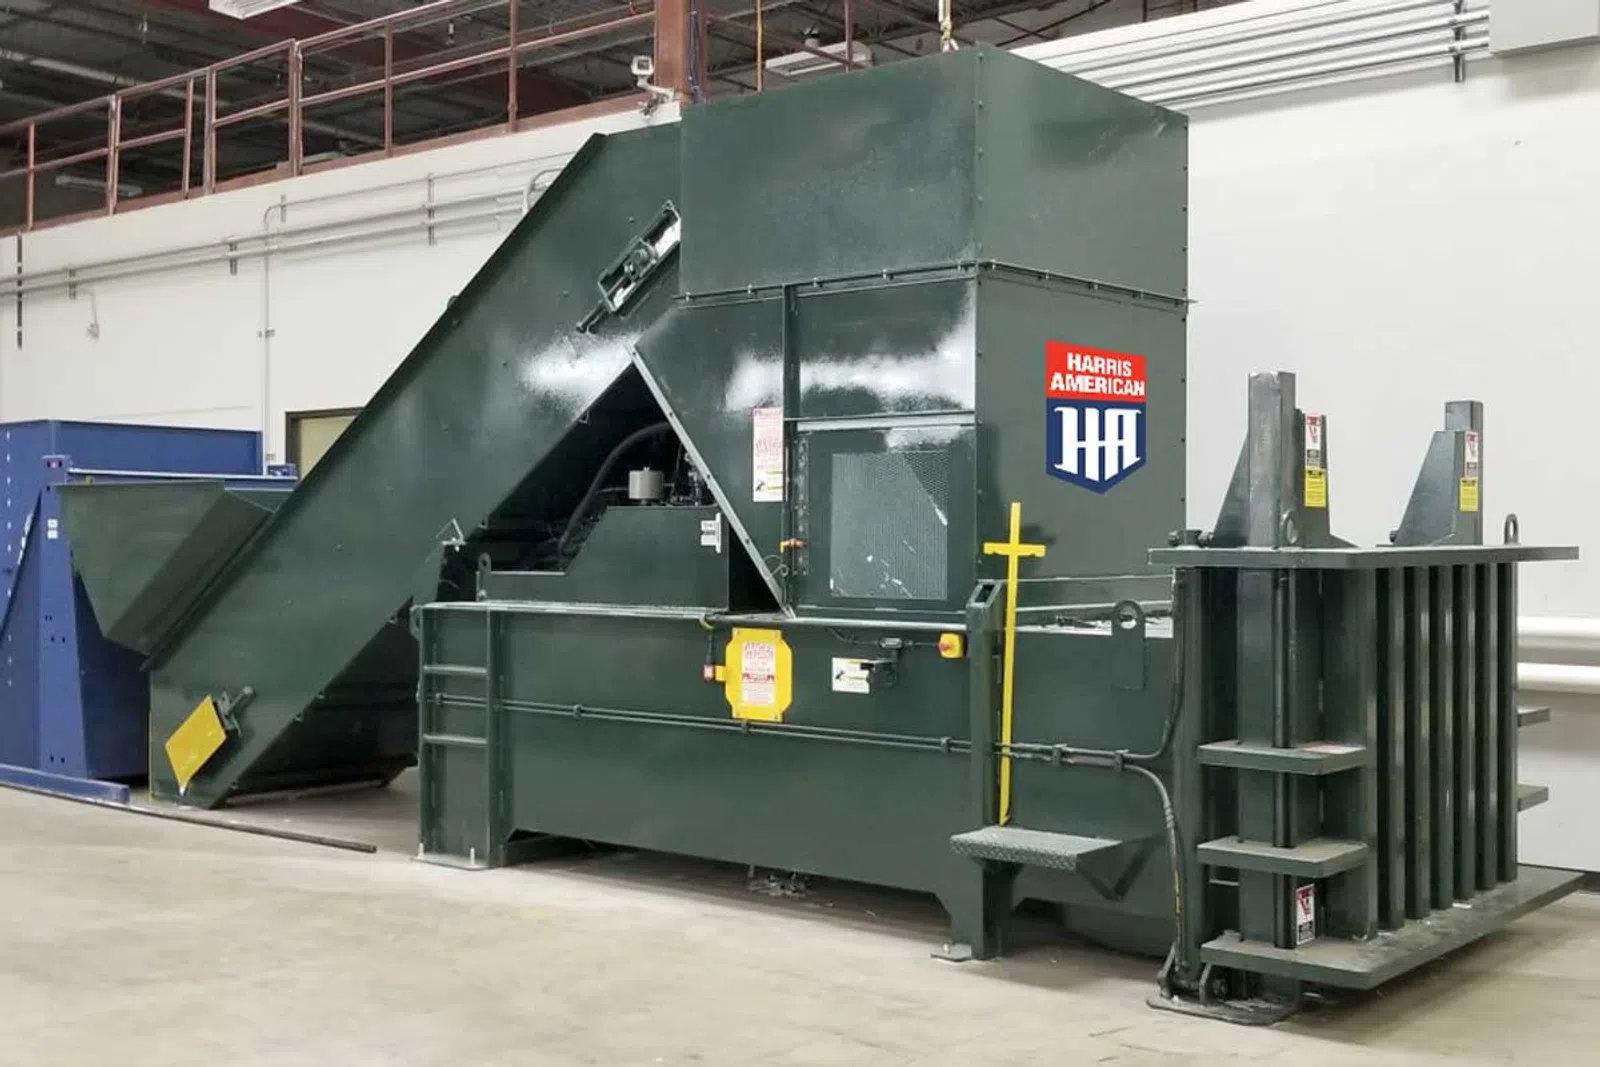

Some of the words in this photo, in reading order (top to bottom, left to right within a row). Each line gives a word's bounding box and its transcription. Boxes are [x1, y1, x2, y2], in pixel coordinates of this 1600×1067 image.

[1067, 352, 1132, 377] HARRIS
[1050, 372, 1145, 396] AMERICAN
[1054, 406, 1142, 482] HA
